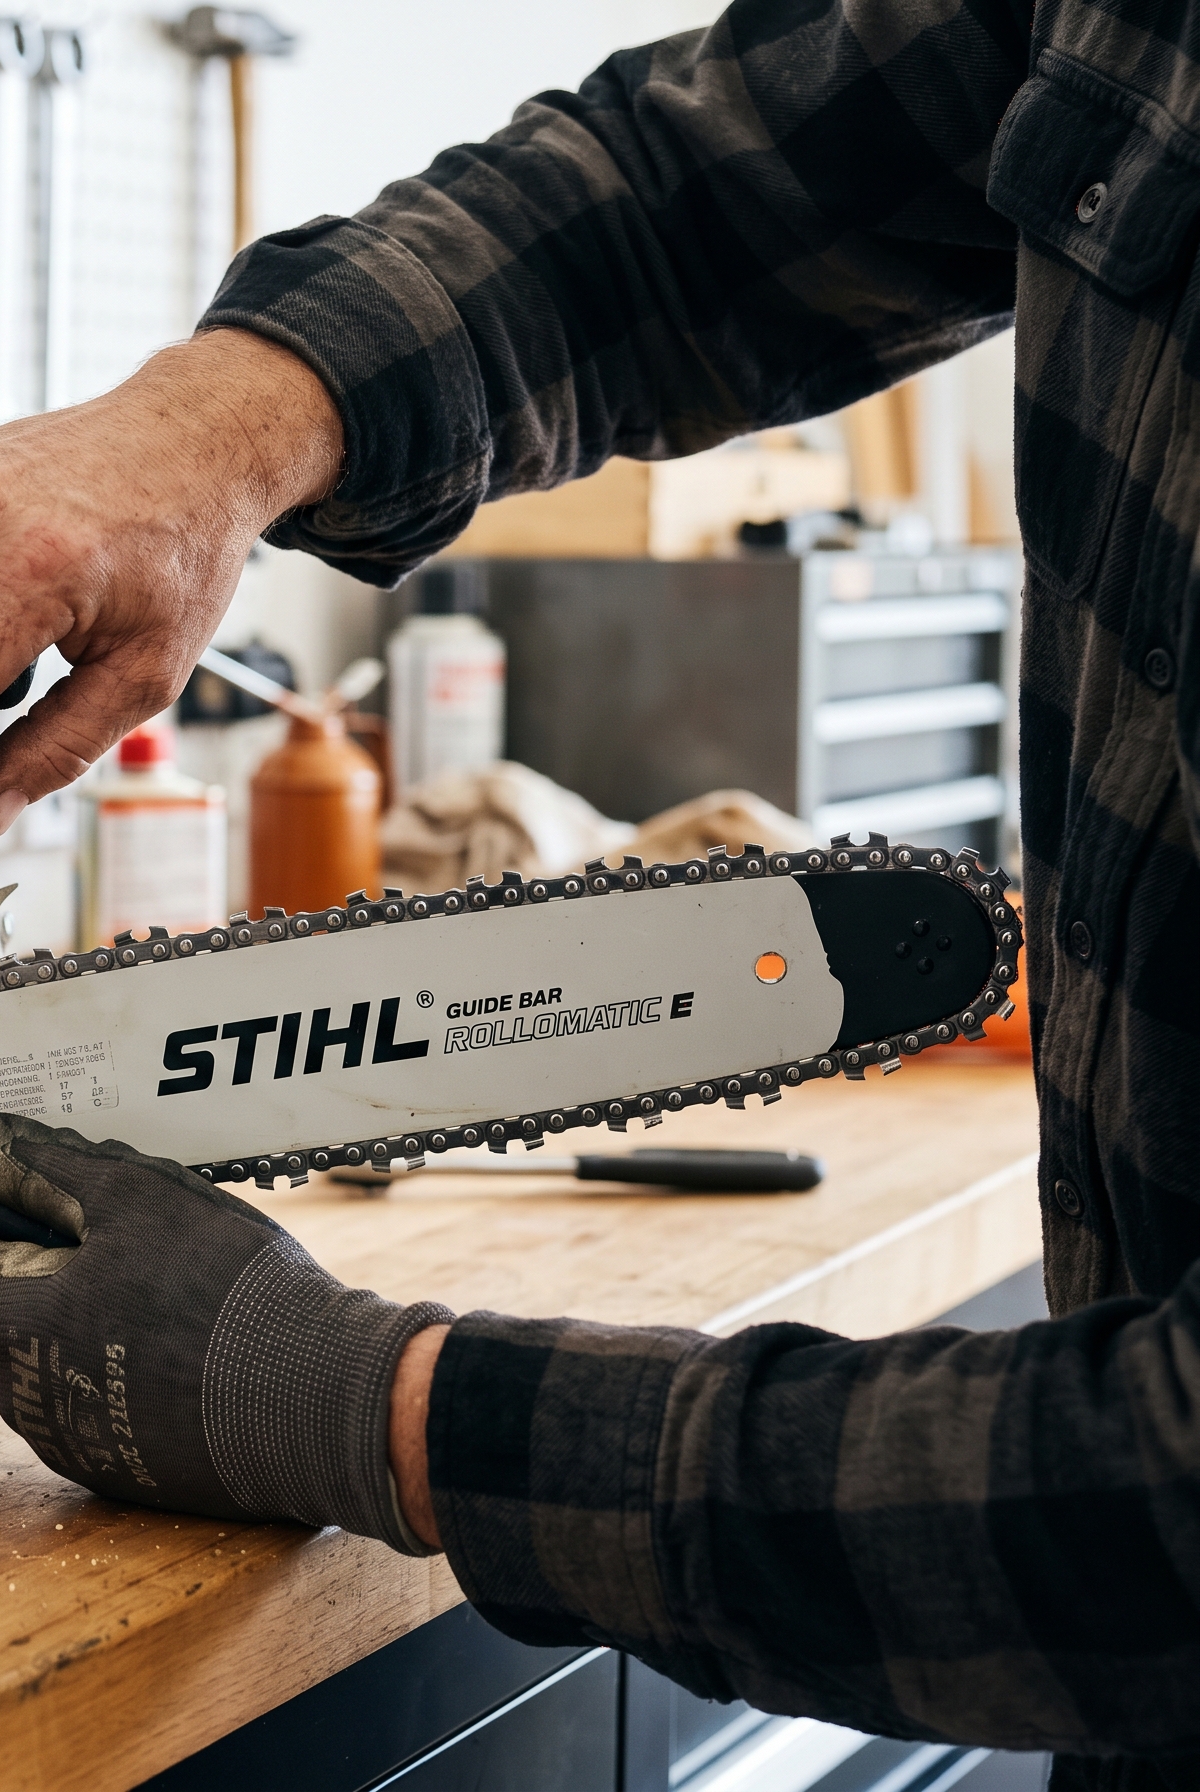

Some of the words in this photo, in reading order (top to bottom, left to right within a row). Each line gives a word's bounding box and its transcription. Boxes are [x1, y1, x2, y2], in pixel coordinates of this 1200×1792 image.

[444, 996, 663, 1055] ROLLOMATIC
[670, 991, 695, 1020] E
[446, 994, 514, 1020] GUIDE
[518, 987, 563, 1009] BAR
